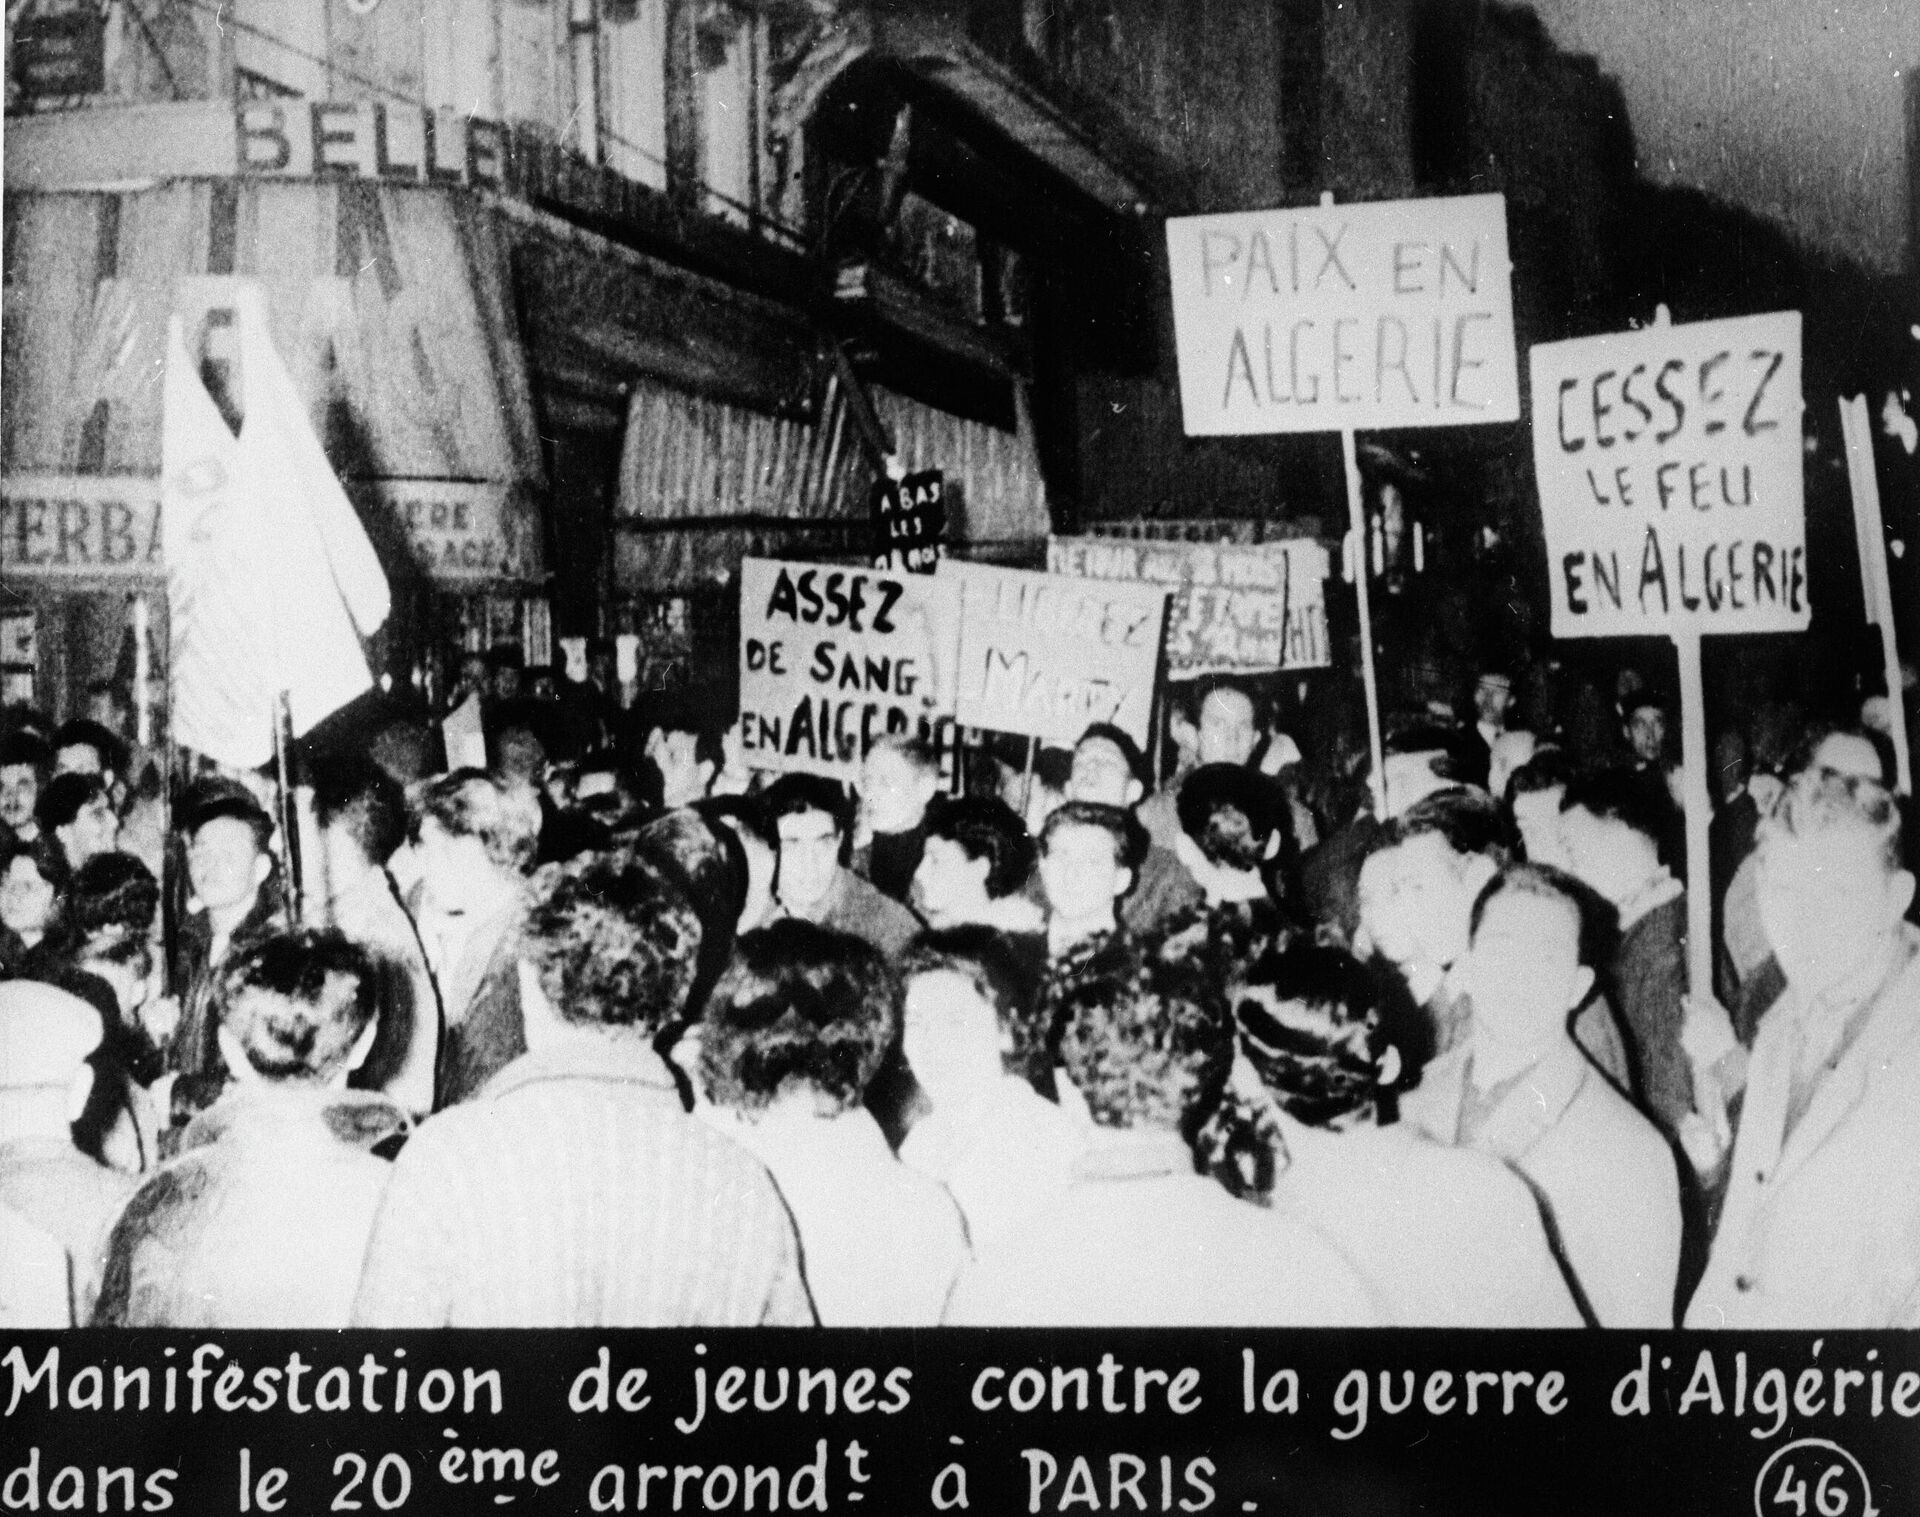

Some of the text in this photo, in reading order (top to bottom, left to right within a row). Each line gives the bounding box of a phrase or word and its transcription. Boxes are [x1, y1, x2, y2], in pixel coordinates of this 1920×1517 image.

[1200, 222, 1481, 302] PAIX EN
[1222, 312, 1494, 410] ALGERIE
[1558, 350, 1785, 454] CESSEZ
[1584, 460, 1752, 513] LE FEU
[766, 566, 904, 634] ASSEZ
[1562, 522, 1806, 615] EN ALGERIE
[746, 637, 921, 697] DE SANG
[741, 711, 781, 753] EN
